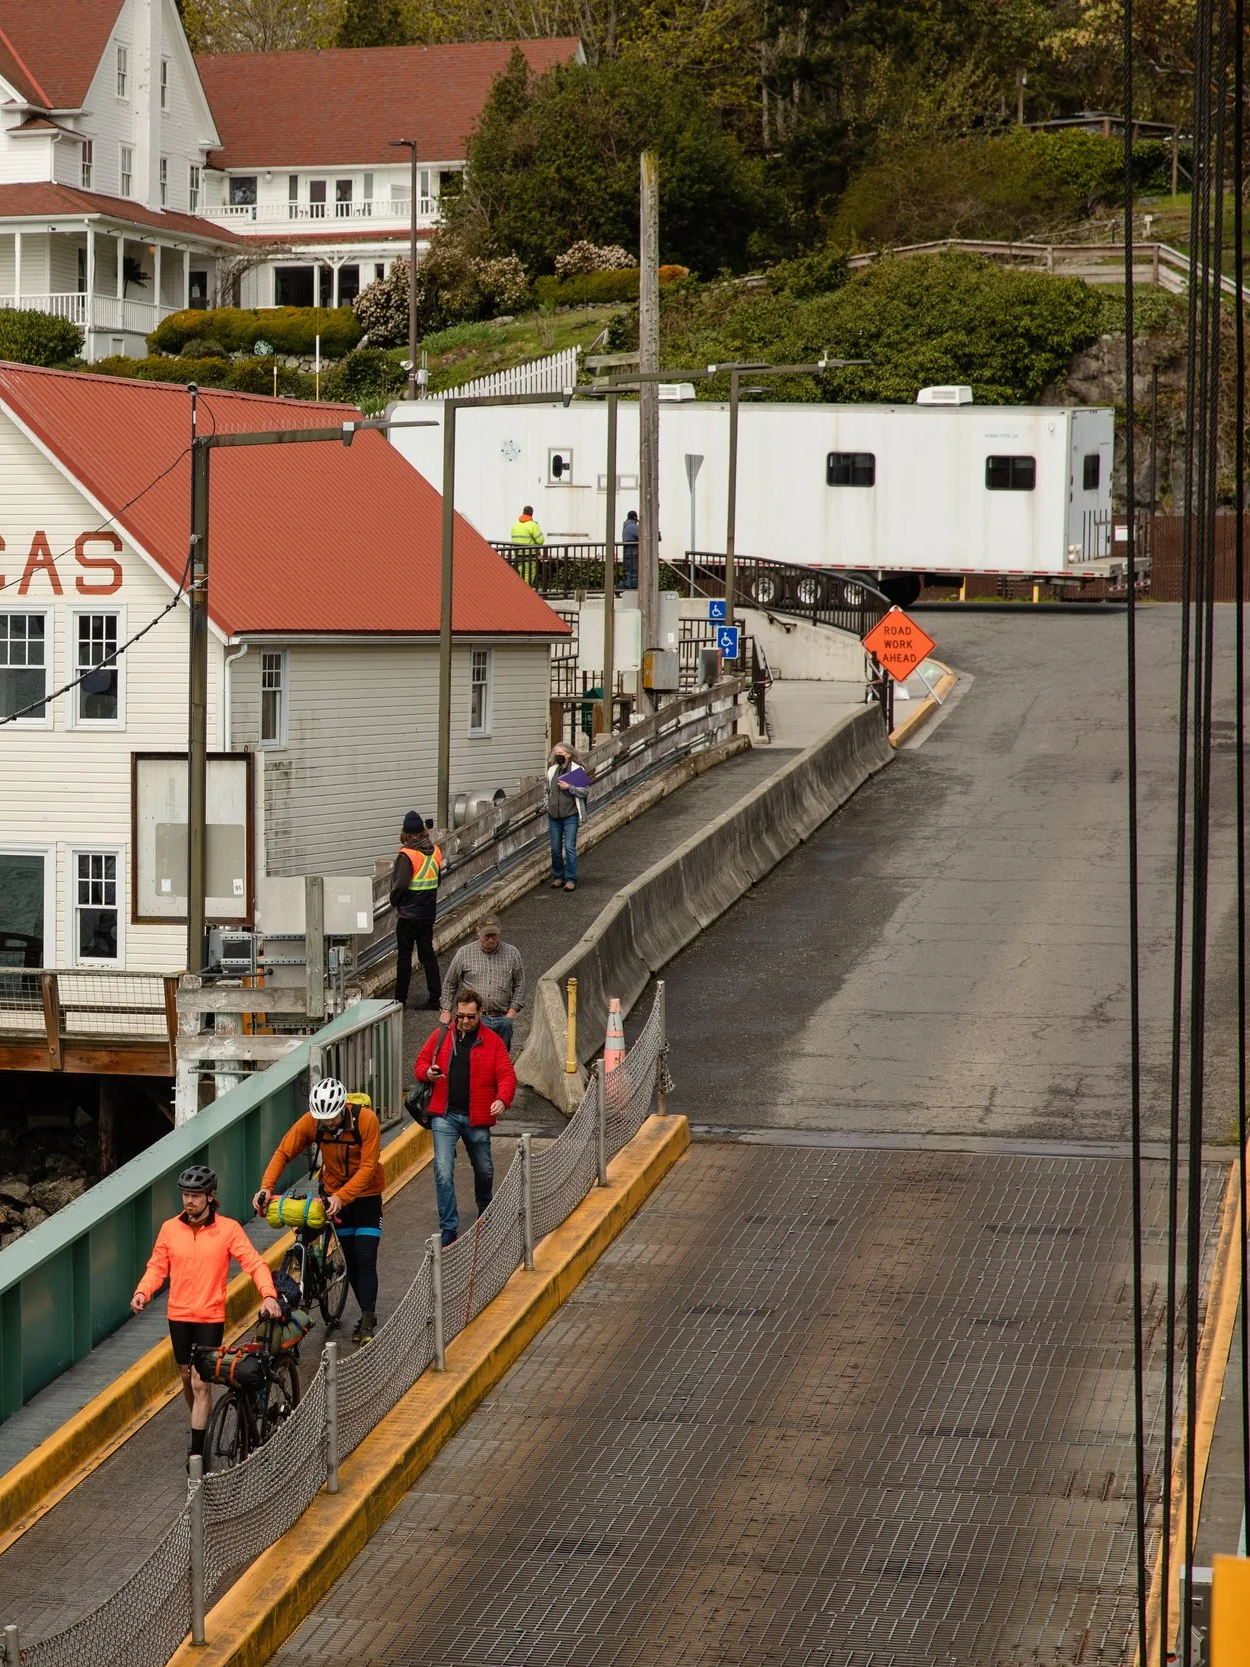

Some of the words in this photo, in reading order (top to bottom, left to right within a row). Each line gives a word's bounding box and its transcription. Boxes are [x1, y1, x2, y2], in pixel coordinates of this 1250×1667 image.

[884, 626, 912, 635] ROAD
[884, 640, 913, 649] WORK
[882, 653, 917, 663] AHEAD
